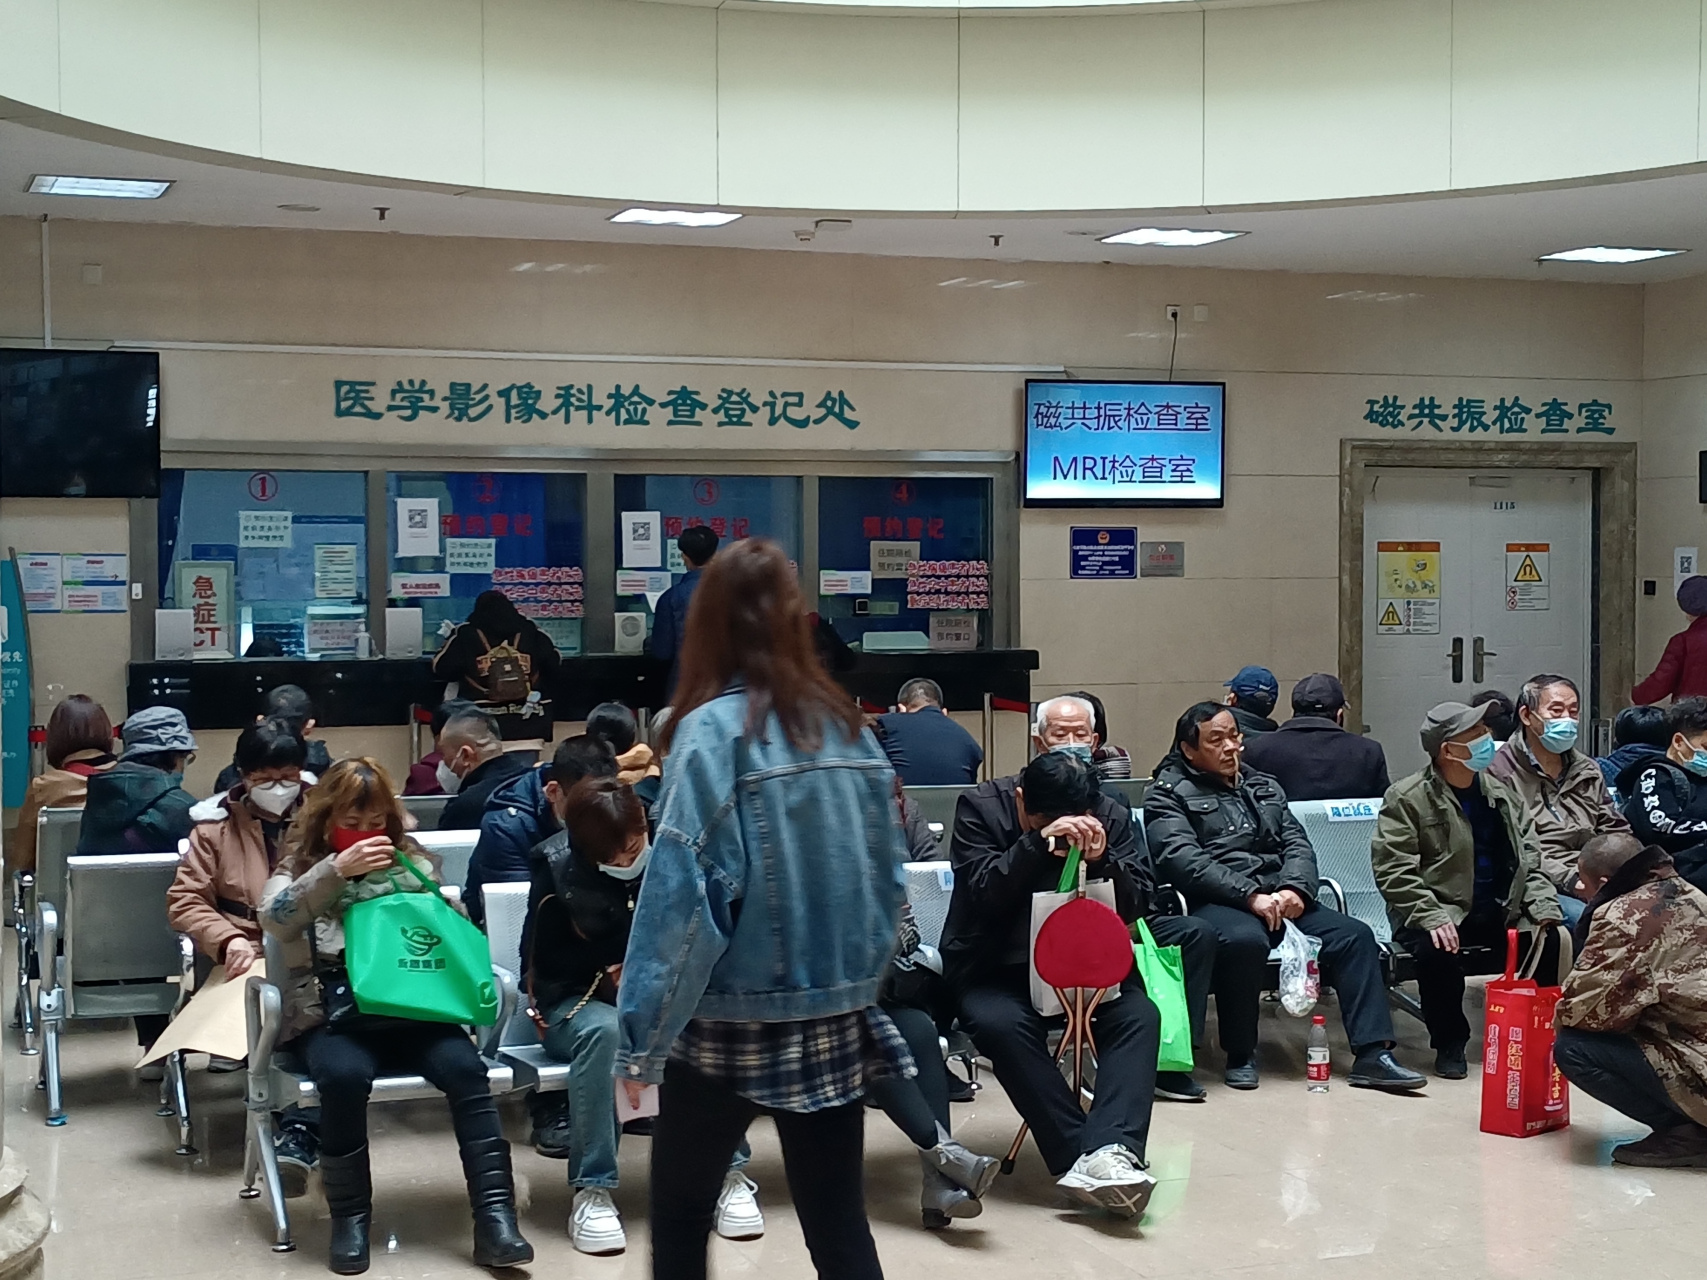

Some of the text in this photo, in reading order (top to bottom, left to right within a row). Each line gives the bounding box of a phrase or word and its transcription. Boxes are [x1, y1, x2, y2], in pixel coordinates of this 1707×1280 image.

[333, 378, 861, 430] 医学影像科检查登记处
[1032, 400, 1212, 433] 磁共振检查室
[1363, 395, 1617, 436] 磁共振检查室
[1052, 454, 1197, 485] MRI检查室
[863, 517, 944, 538] 预约登记
